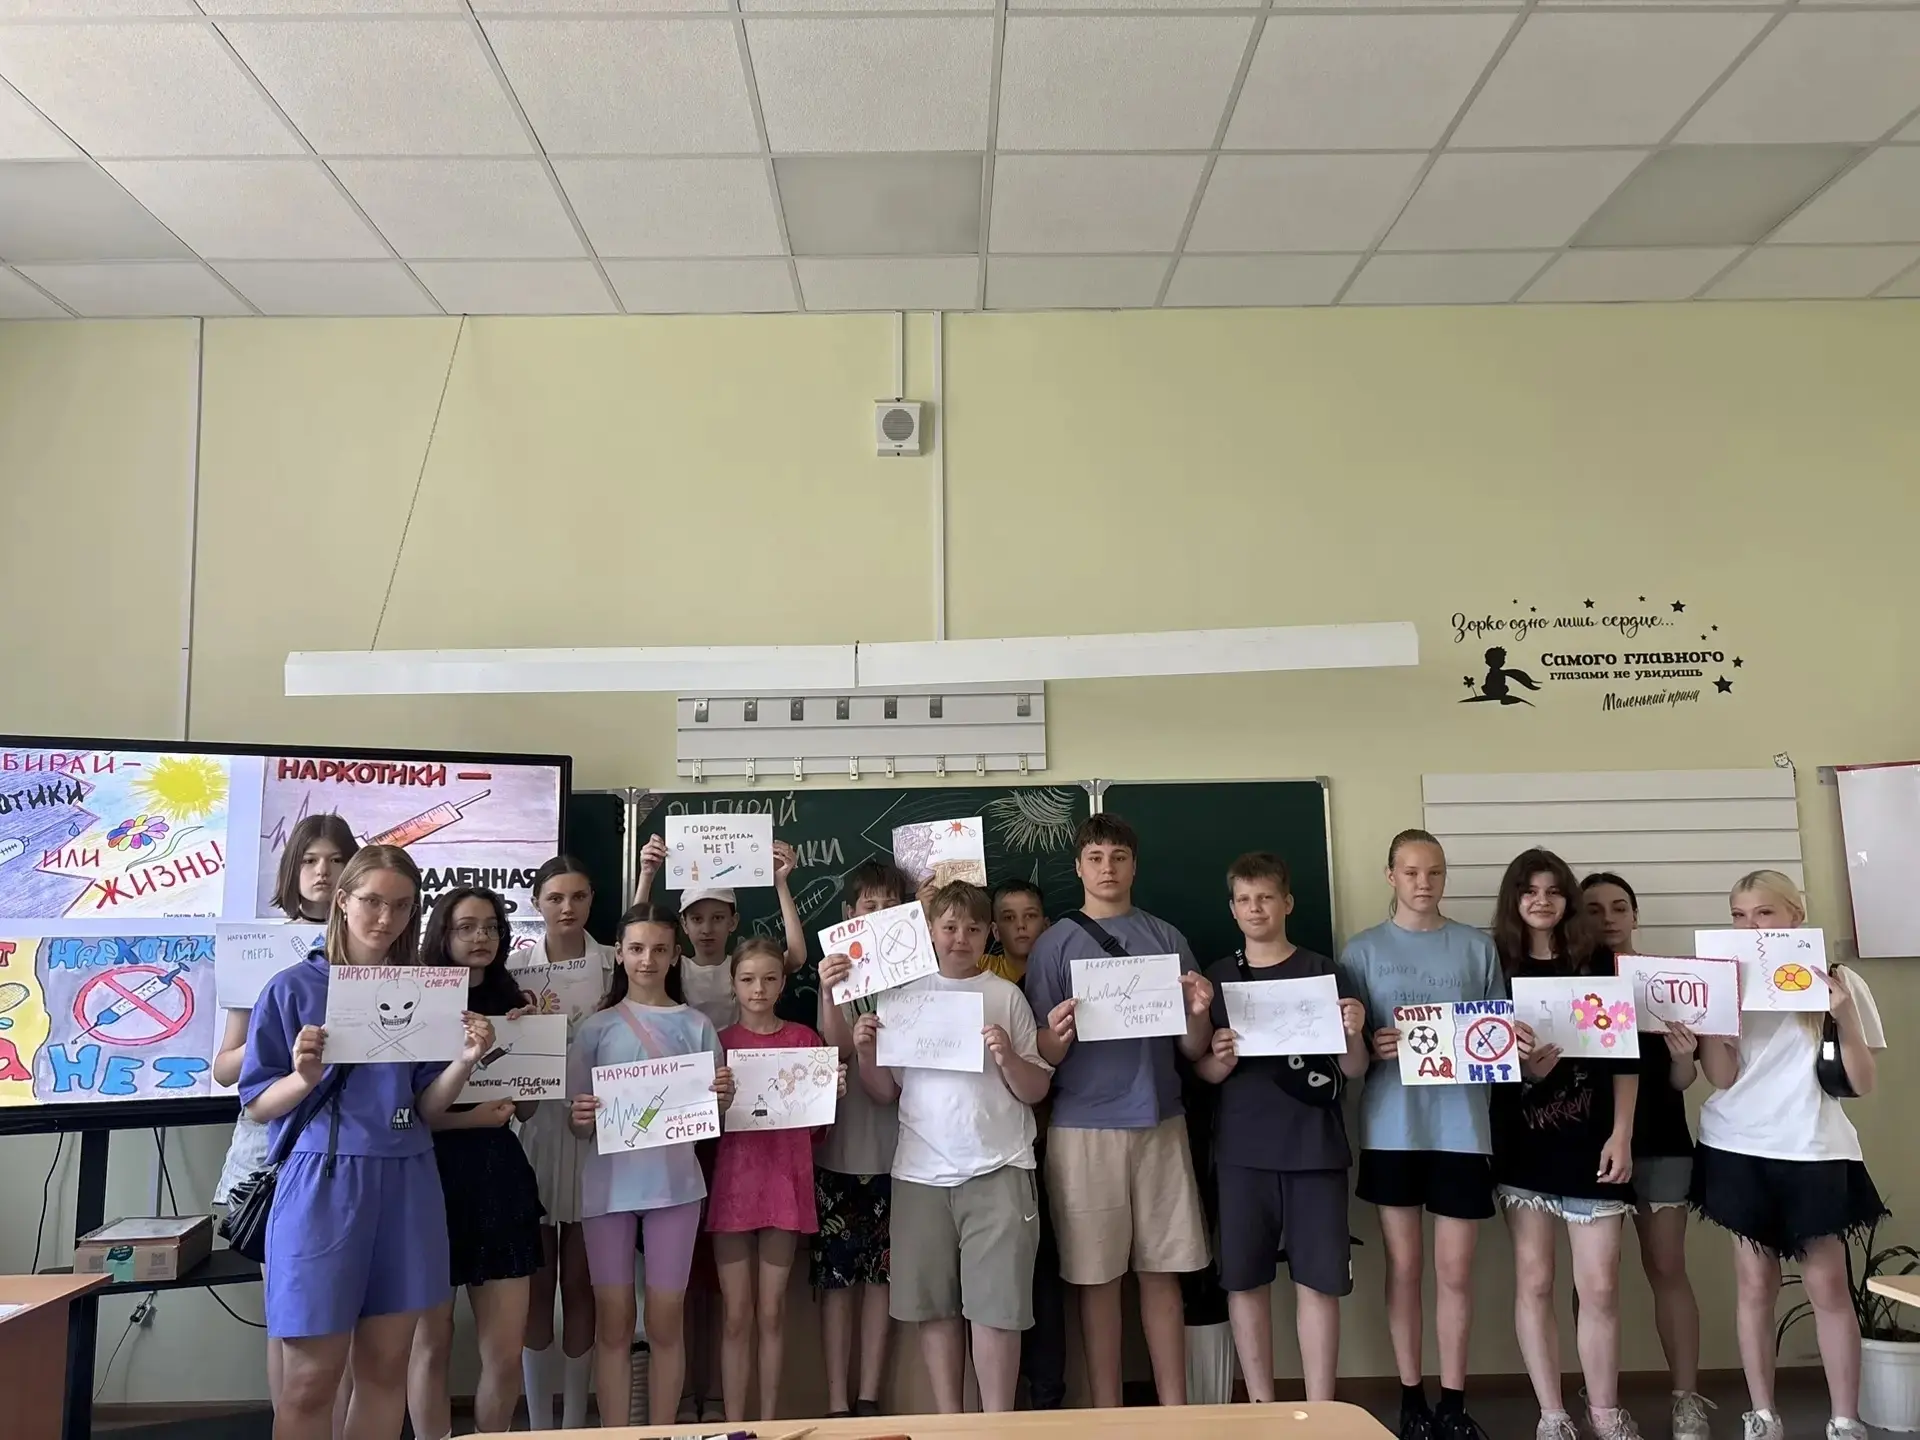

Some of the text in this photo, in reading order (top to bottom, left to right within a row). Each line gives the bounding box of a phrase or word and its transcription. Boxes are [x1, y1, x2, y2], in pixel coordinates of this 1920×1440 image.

[1451, 612, 1507, 643] Зорко
[1509, 617, 1549, 642] одно
[1553, 616, 1597, 628] лишь
[1541, 650, 1724, 667] Самого главного
[1550, 669, 1703, 680] глазами не увидишь
[1602, 689, 1700, 711] Маленький принц
[278, 758, 446, 786] НАРКОТИКИ
[683, 825, 727, 834] ГОВОРИМ
[701, 833, 754, 841] НАРКОТИКАМ
[703, 841, 735, 854] НЕТ!
[43, 848, 100, 868] ИЛИ
[94, 840, 225, 909] ЖИЗНЬ!
[419, 867, 541, 892] ДЛЕННАЯ
[241, 947, 275, 961] СМЕРТЬ
[1085, 957, 1146, 970] НАРКОТИКИ
[338, 966, 402, 981] НАРКОТИКИ
[1651, 978, 1708, 1009] СТОП
[1393, 1005, 1443, 1022] СПОРТ
[47, 1043, 210, 1095] НЕТ
[596, 1062, 679, 1081] НАРКОТИКИ
[1468, 1063, 1512, 1084] НЕТ
[665, 1109, 714, 1125] медленная
[665, 1121, 716, 1140] СМЕРТЬ
